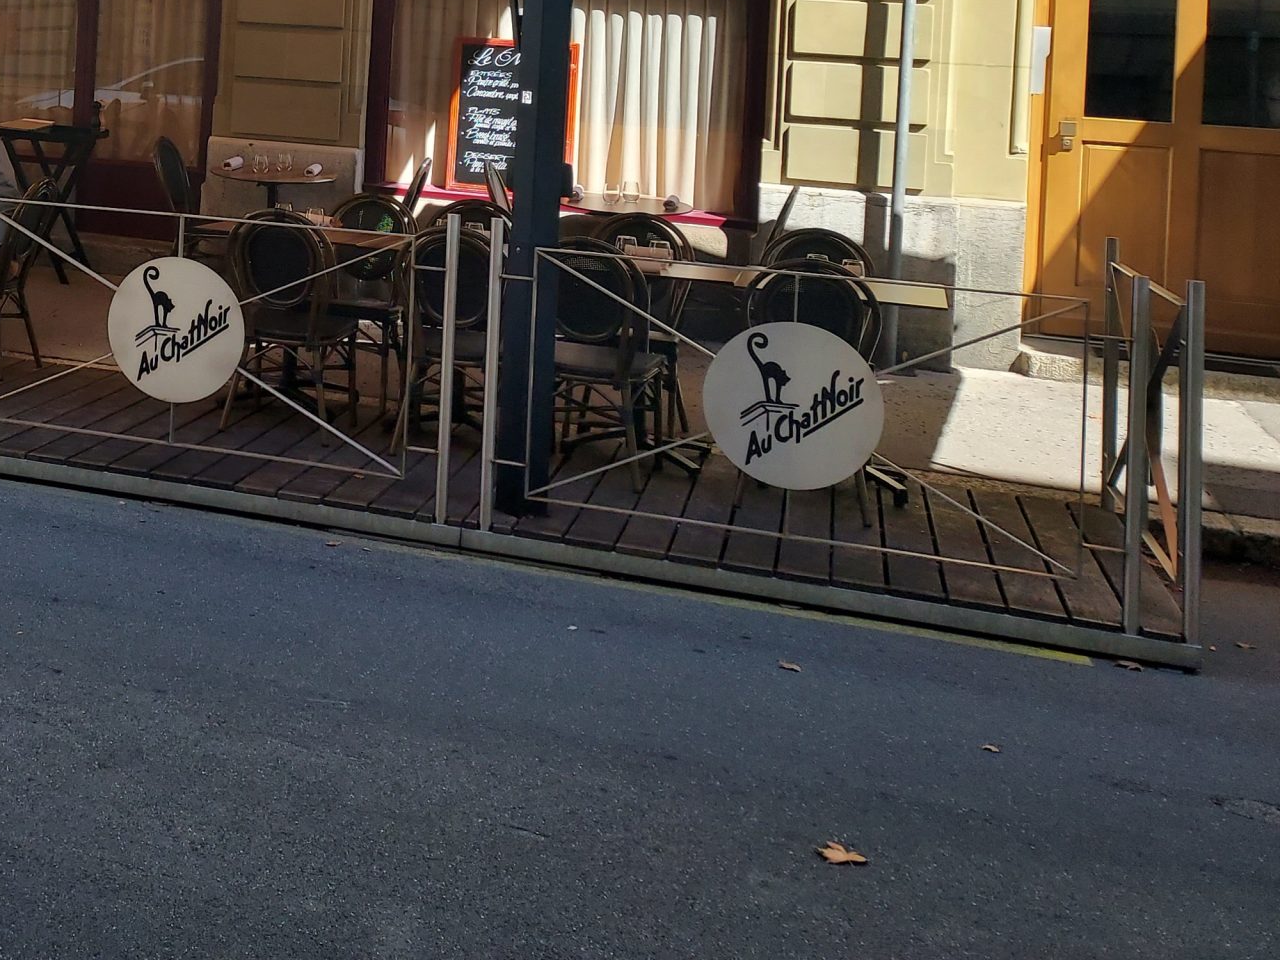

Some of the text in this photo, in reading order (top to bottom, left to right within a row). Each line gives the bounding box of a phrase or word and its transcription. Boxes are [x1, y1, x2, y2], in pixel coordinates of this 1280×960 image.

[468, 47, 495, 66] Le
[136, 350, 159, 382] Au
[745, 430, 772, 465] Au
